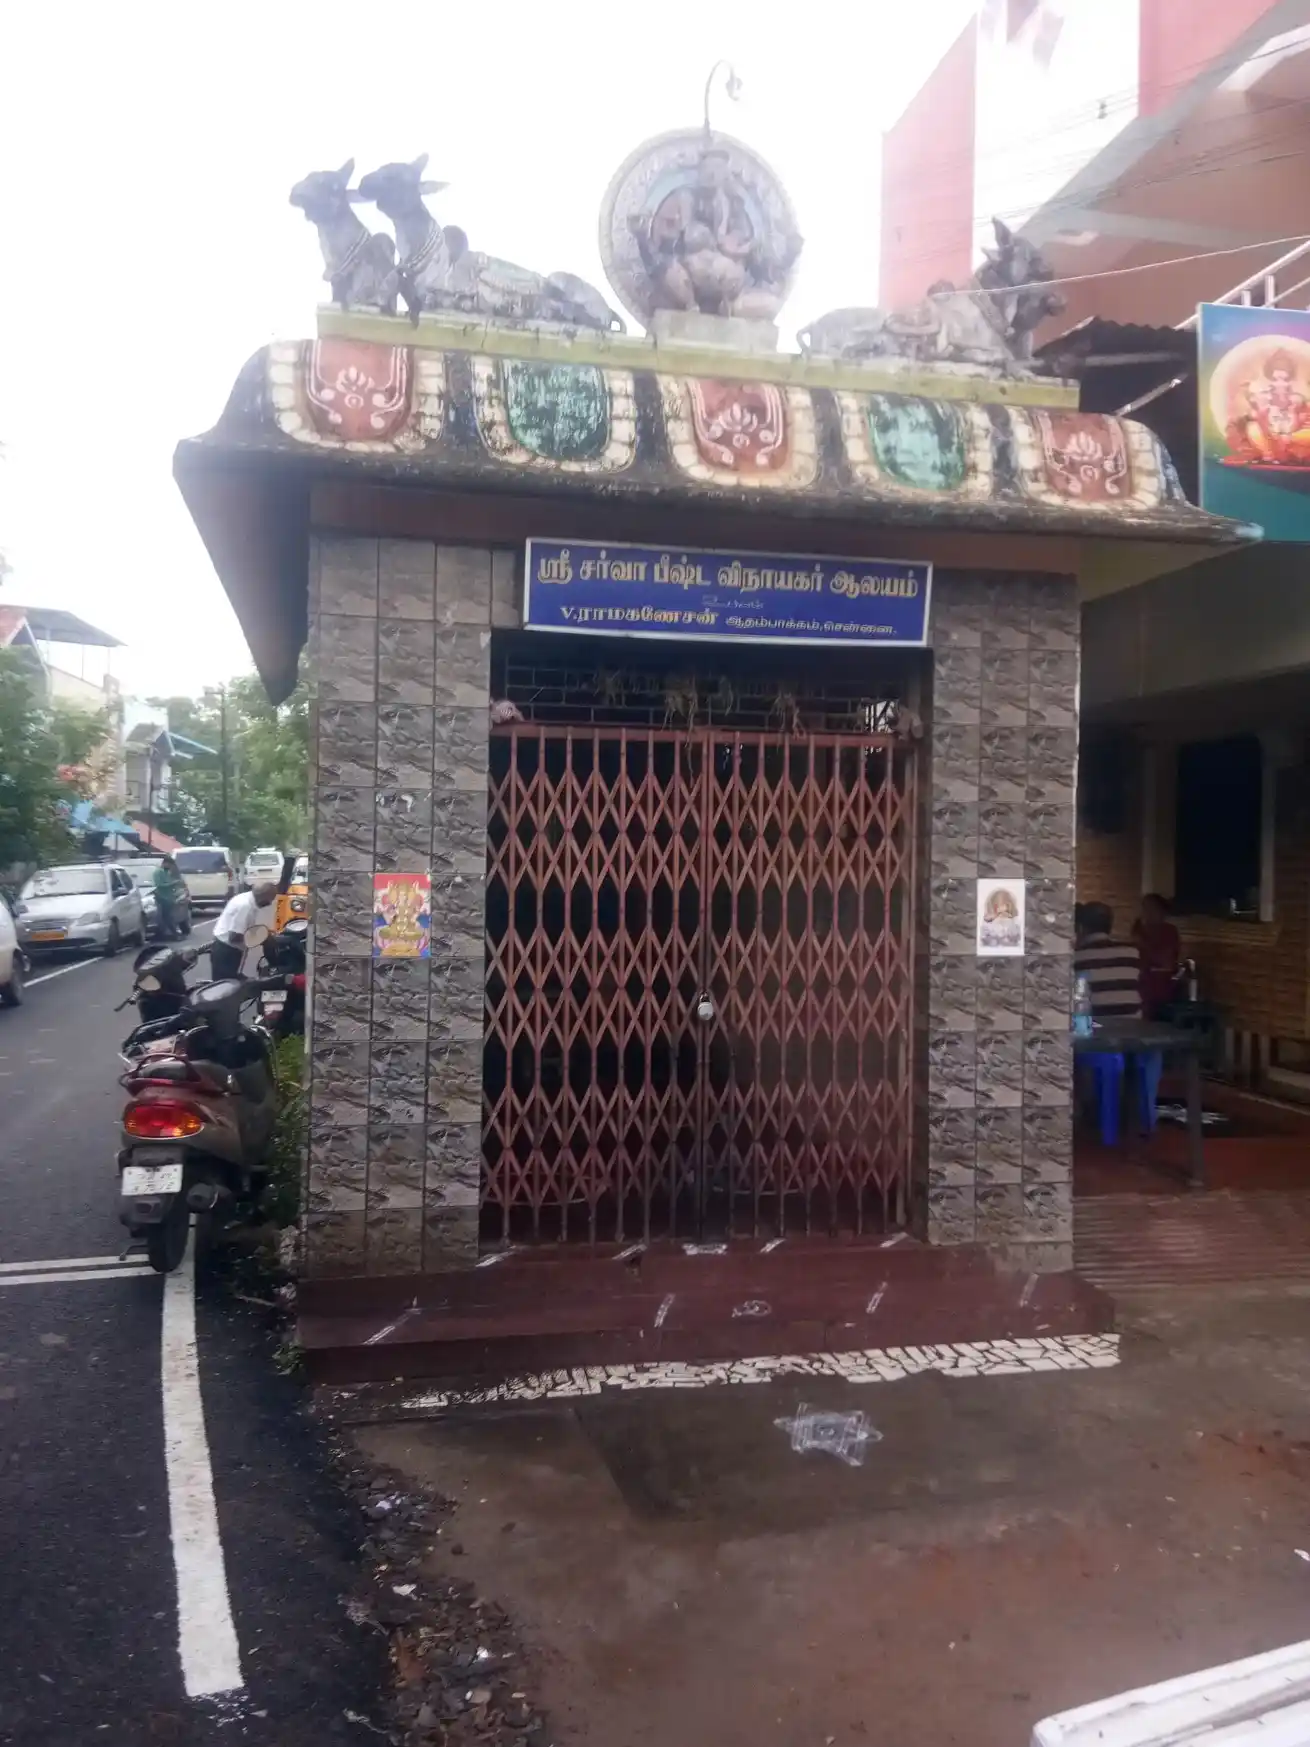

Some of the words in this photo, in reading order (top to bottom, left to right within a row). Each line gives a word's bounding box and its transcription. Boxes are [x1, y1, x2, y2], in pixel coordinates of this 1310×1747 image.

[579, 549, 648, 583] சர்வா
[653, 553, 711, 591] பீஷ்ட
[717, 560, 825, 595] விநாயகர்
[829, 569, 919, 599] ஆலயம்
